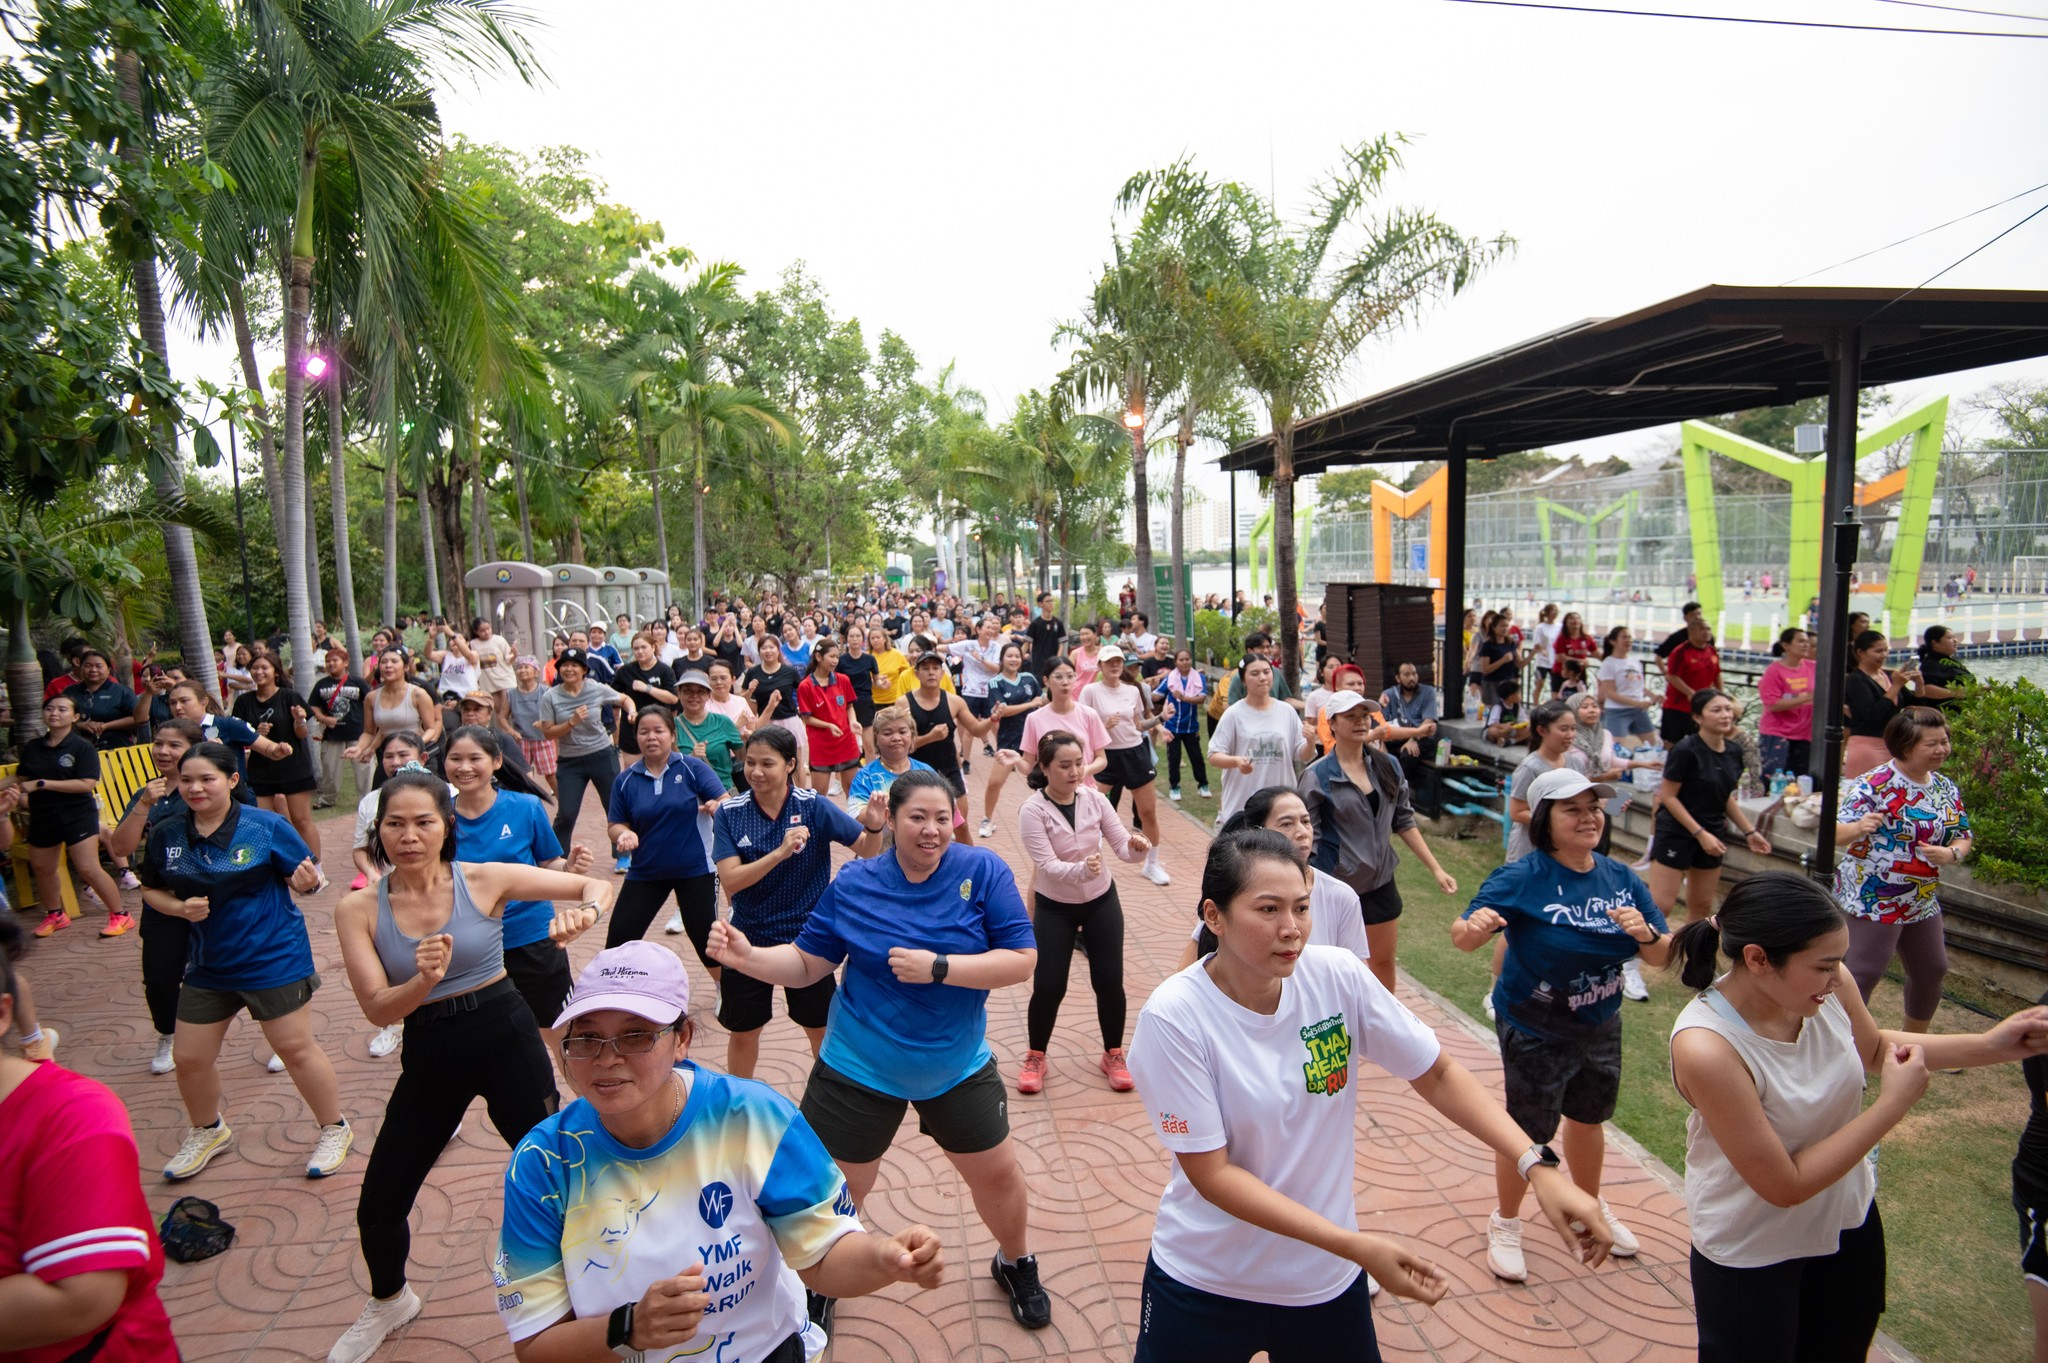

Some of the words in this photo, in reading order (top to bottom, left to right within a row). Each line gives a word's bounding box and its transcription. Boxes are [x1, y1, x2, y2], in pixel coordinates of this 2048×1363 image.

[1307, 1024, 1348, 1062] THAI
[1305, 1049, 1349, 1081] HEALT
[1308, 1078, 1327, 1091] DAY
[1327, 1067, 1347, 1094] RU
[1162, 1120, 1189, 1133] สสส
[698, 1233, 743, 1266] YMF
[702, 1259, 753, 1293] Walk
[498, 1290, 523, 1311] Run
